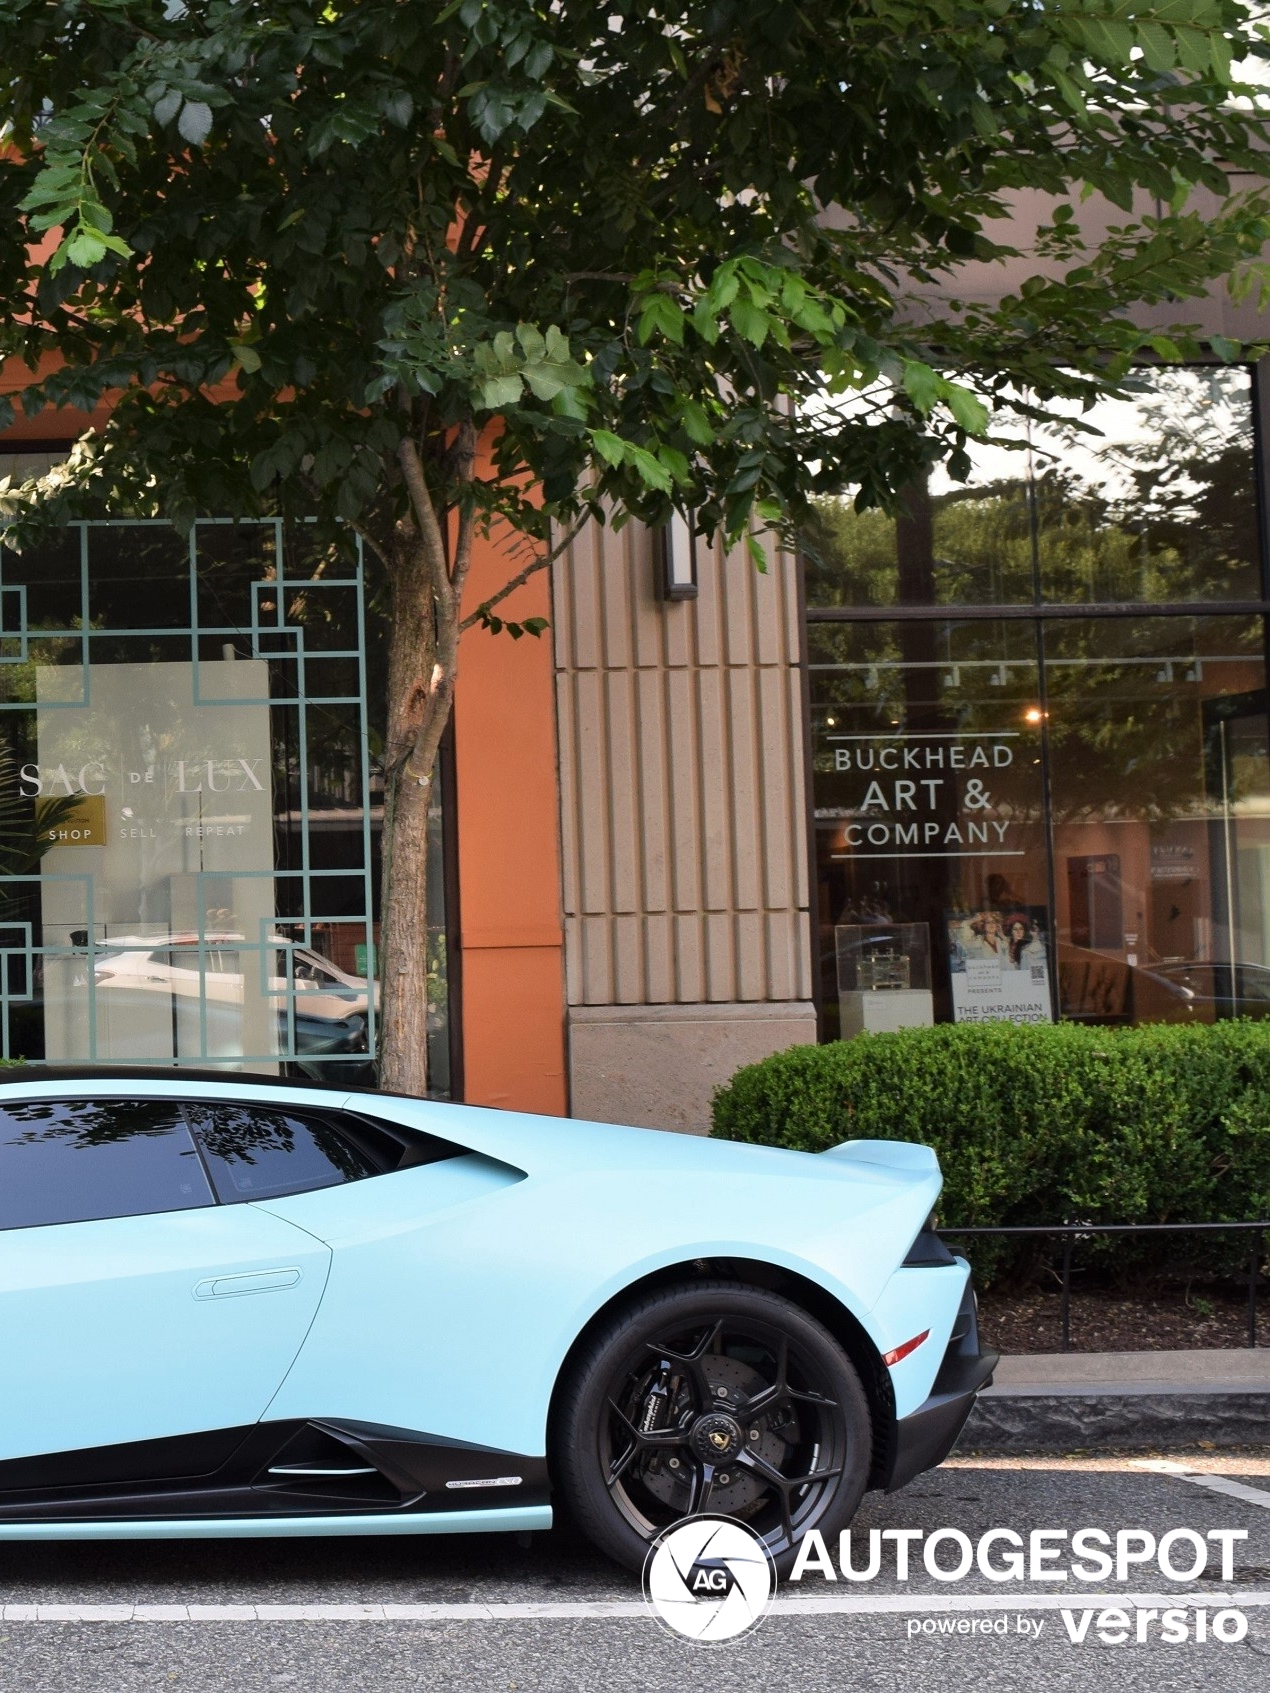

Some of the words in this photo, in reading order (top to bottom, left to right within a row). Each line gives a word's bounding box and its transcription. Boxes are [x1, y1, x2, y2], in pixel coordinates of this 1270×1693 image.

[835, 745, 1013, 771] BUCKHEAD
[19, 761, 106, 797] SAC
[173, 758, 267, 793] LUX
[860, 779, 944, 811] ART
[963, 778, 992, 809] &
[48, 829, 92, 840] SHOP
[120, 828, 157, 839] SELL
[184, 826, 245, 837] REPEAT
[843, 820, 1010, 846] COMPANY
[957, 1005, 979, 1015] THE
[982, 1003, 1043, 1014] UKRAINIAN
